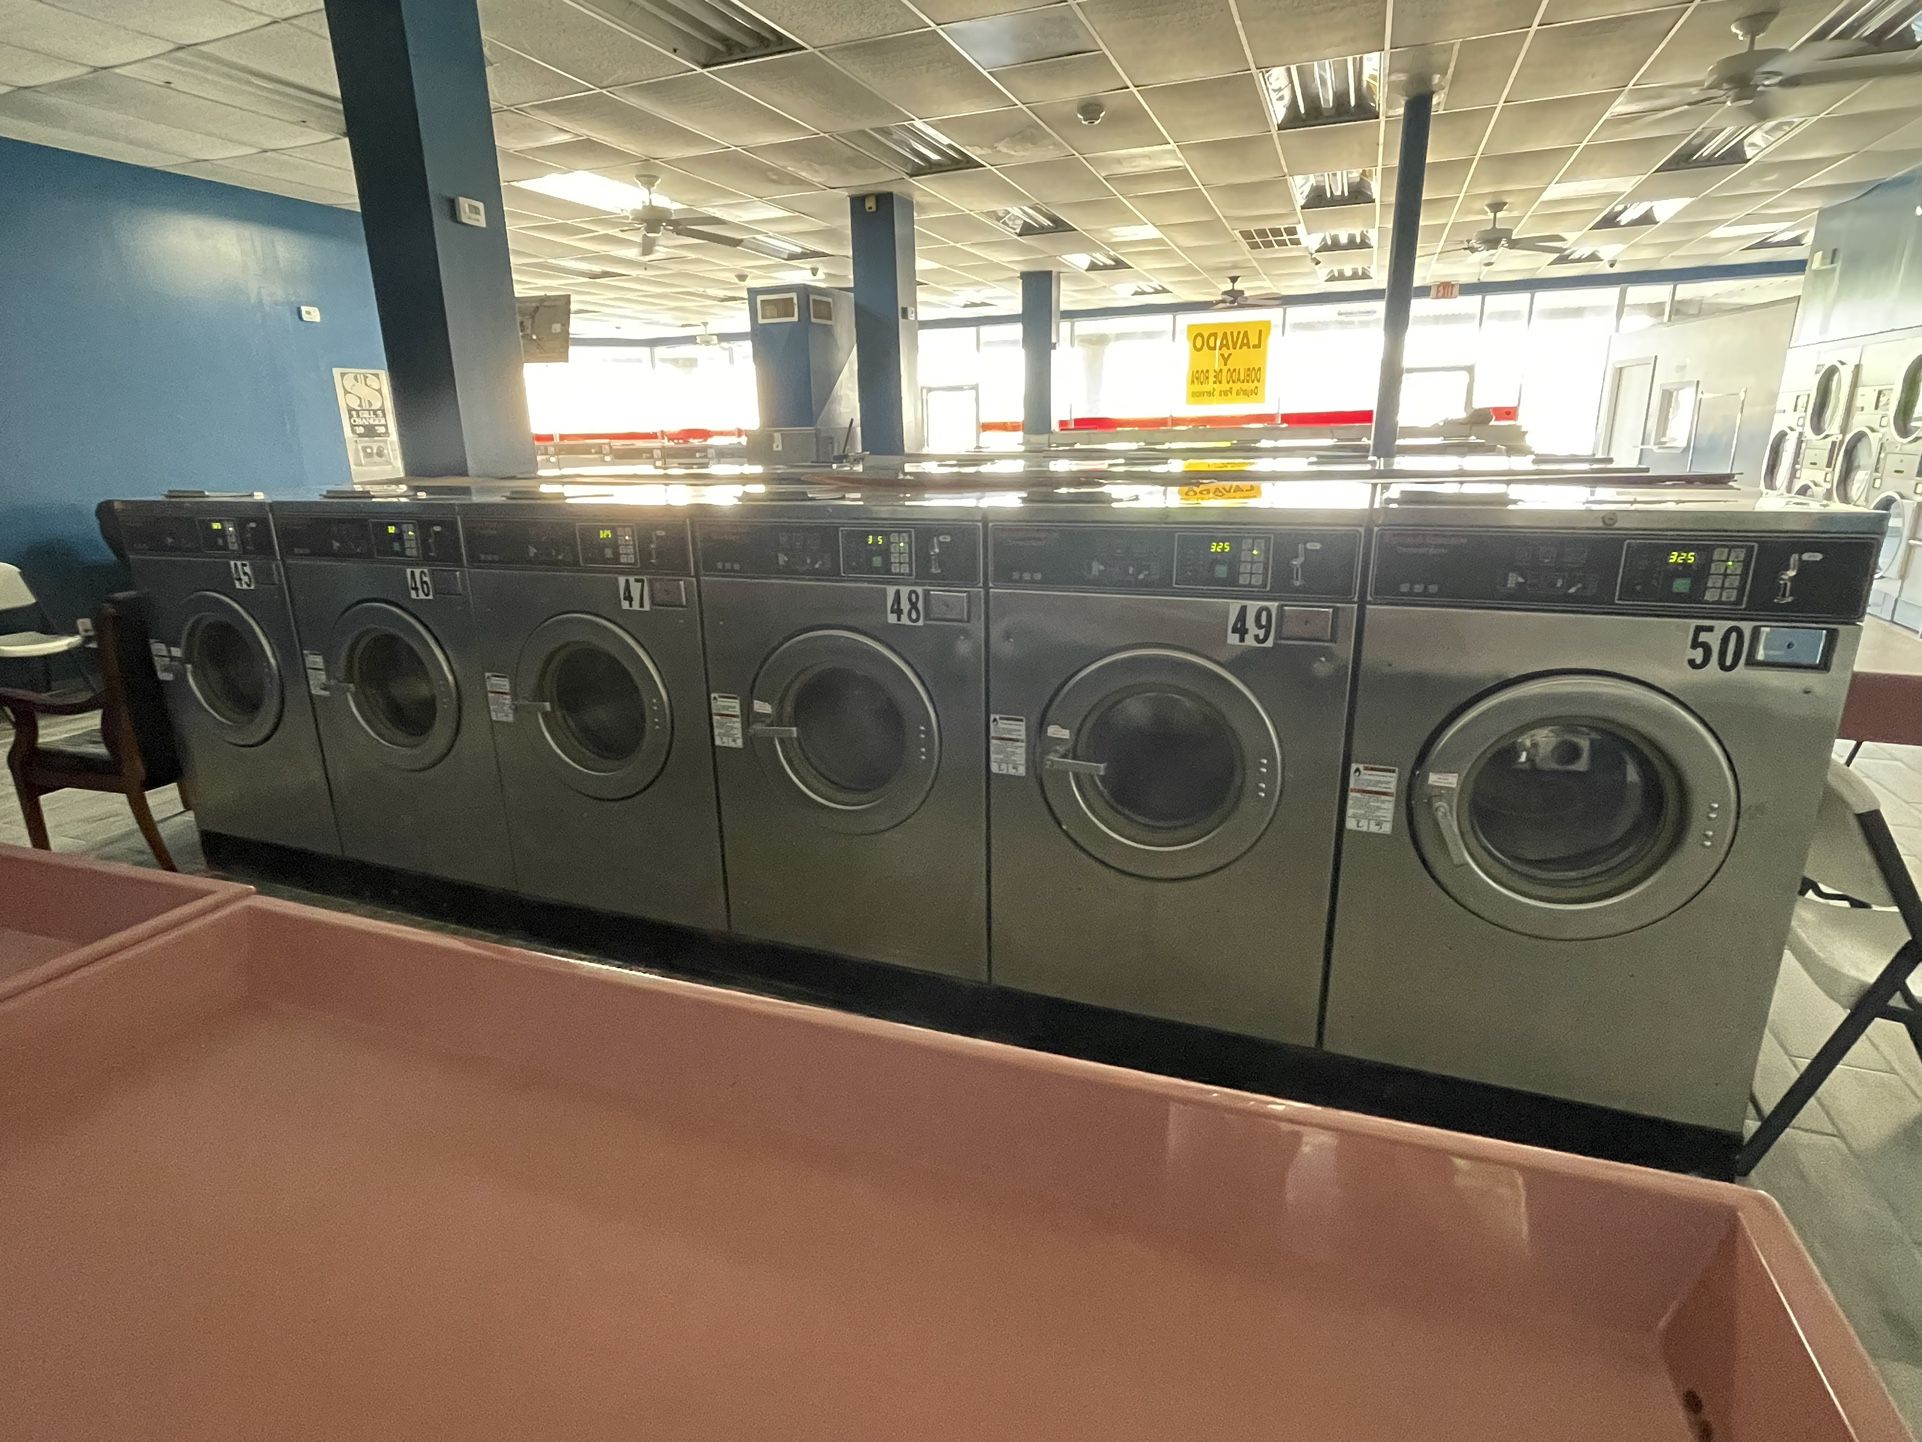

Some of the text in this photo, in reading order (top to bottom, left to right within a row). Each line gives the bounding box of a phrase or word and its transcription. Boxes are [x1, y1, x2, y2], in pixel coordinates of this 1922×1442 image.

[1210, 542, 1231, 553] 325
[1668, 551, 1696, 564] 325
[233, 562, 253, 588] 45
[409, 569, 431, 597] 46
[623, 578, 645, 608] 47
[889, 588, 921, 623] 48
[1230, 604, 1273, 645] 49
[1687, 624, 1745, 672] 50
